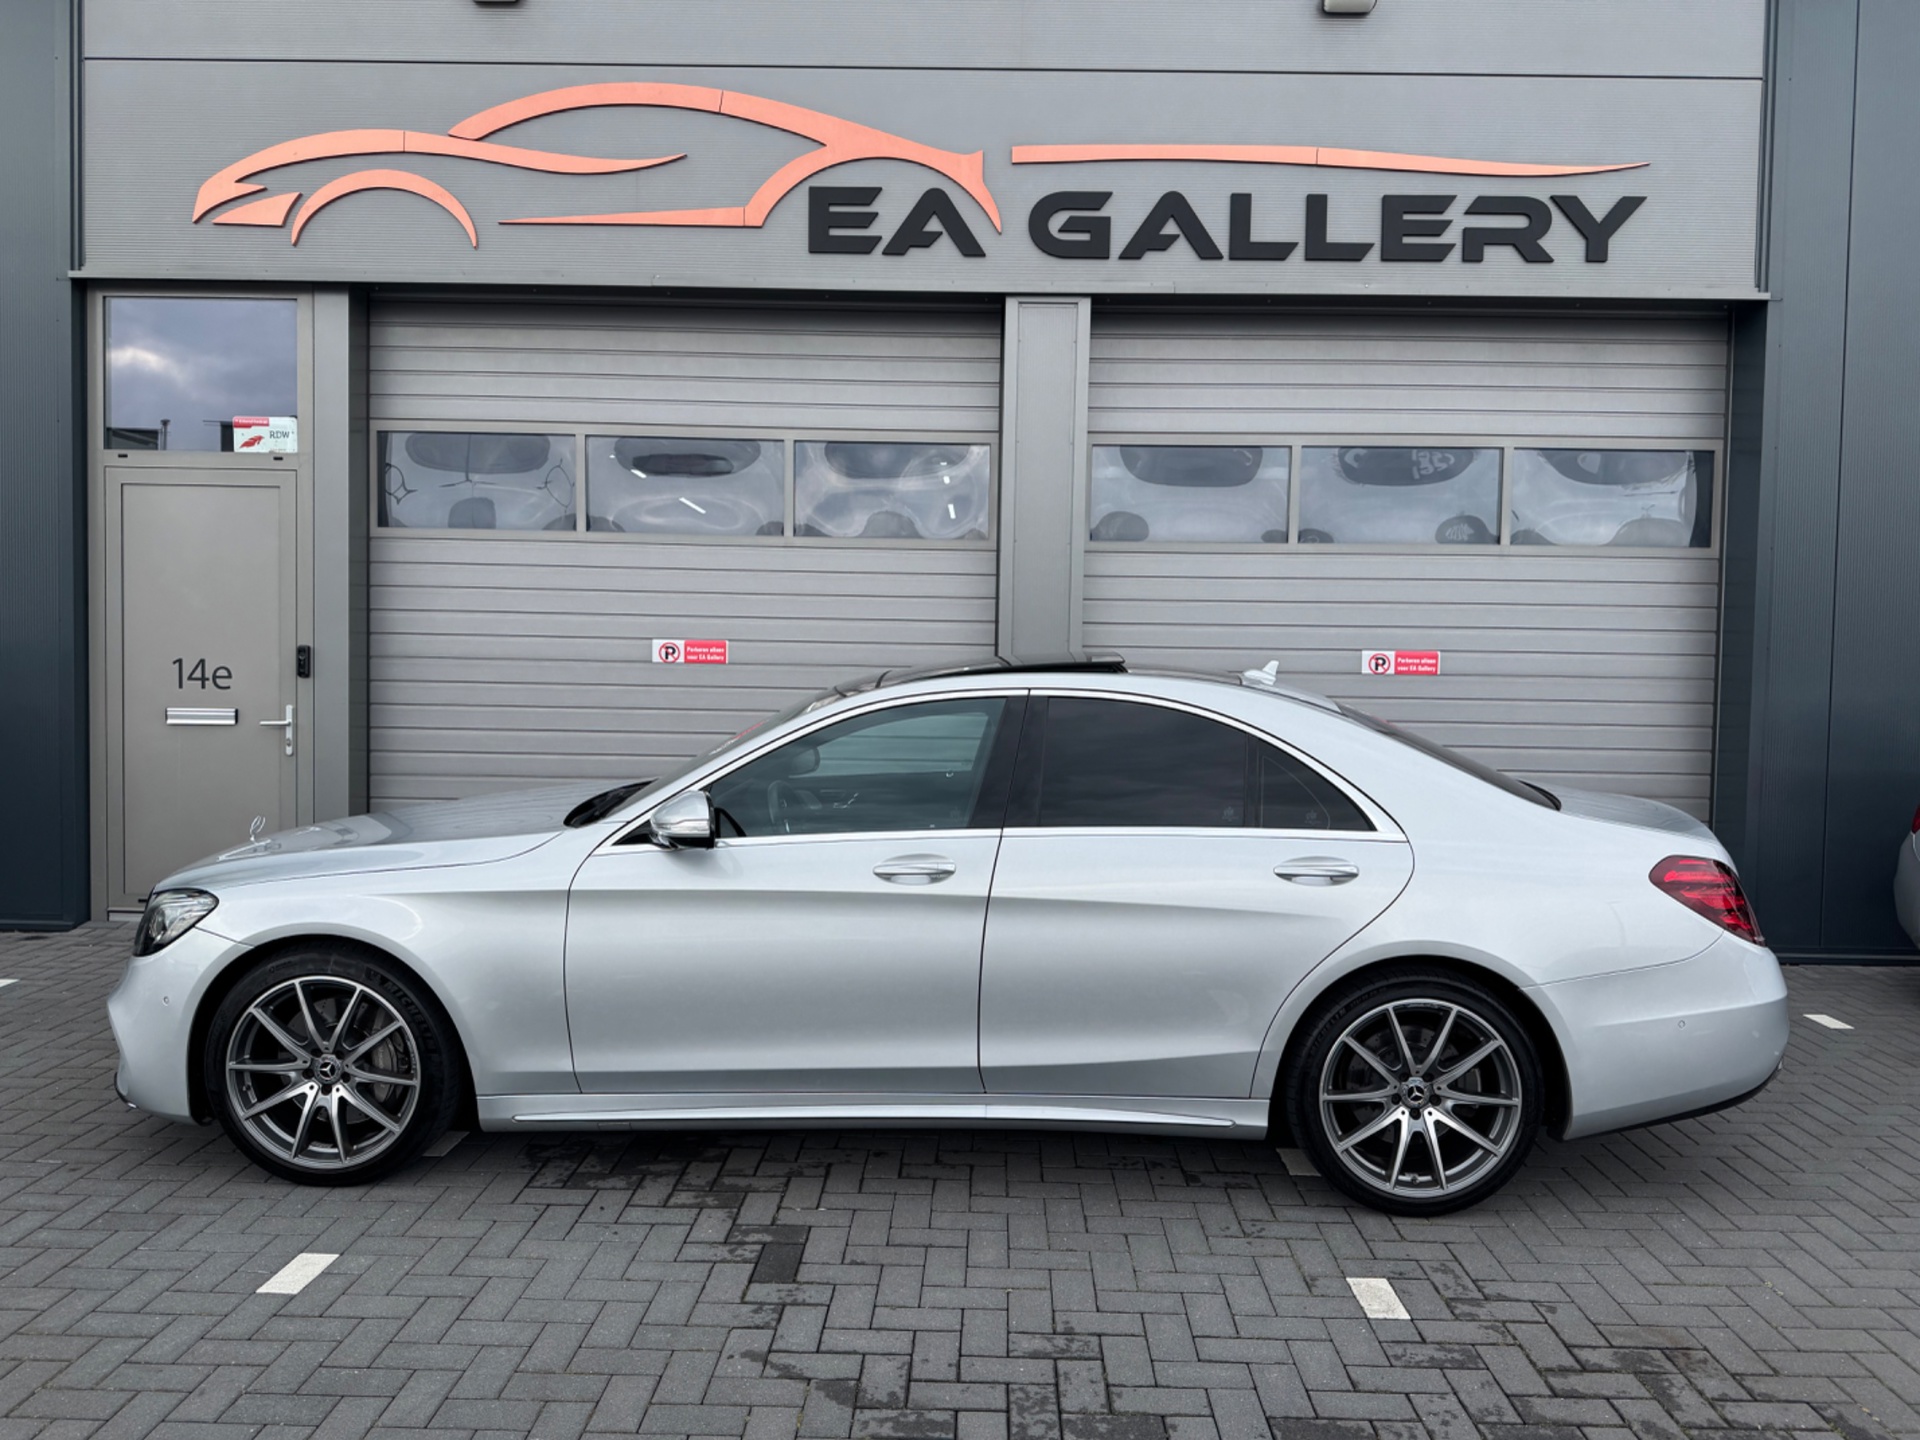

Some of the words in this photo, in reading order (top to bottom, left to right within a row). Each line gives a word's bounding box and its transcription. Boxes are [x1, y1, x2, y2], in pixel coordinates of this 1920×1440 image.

[808, 186, 987, 258] EA
[1028, 190, 1649, 264] GALLERY
[269, 430, 290, 439] RDW
[172, 657, 233, 690] 14e
